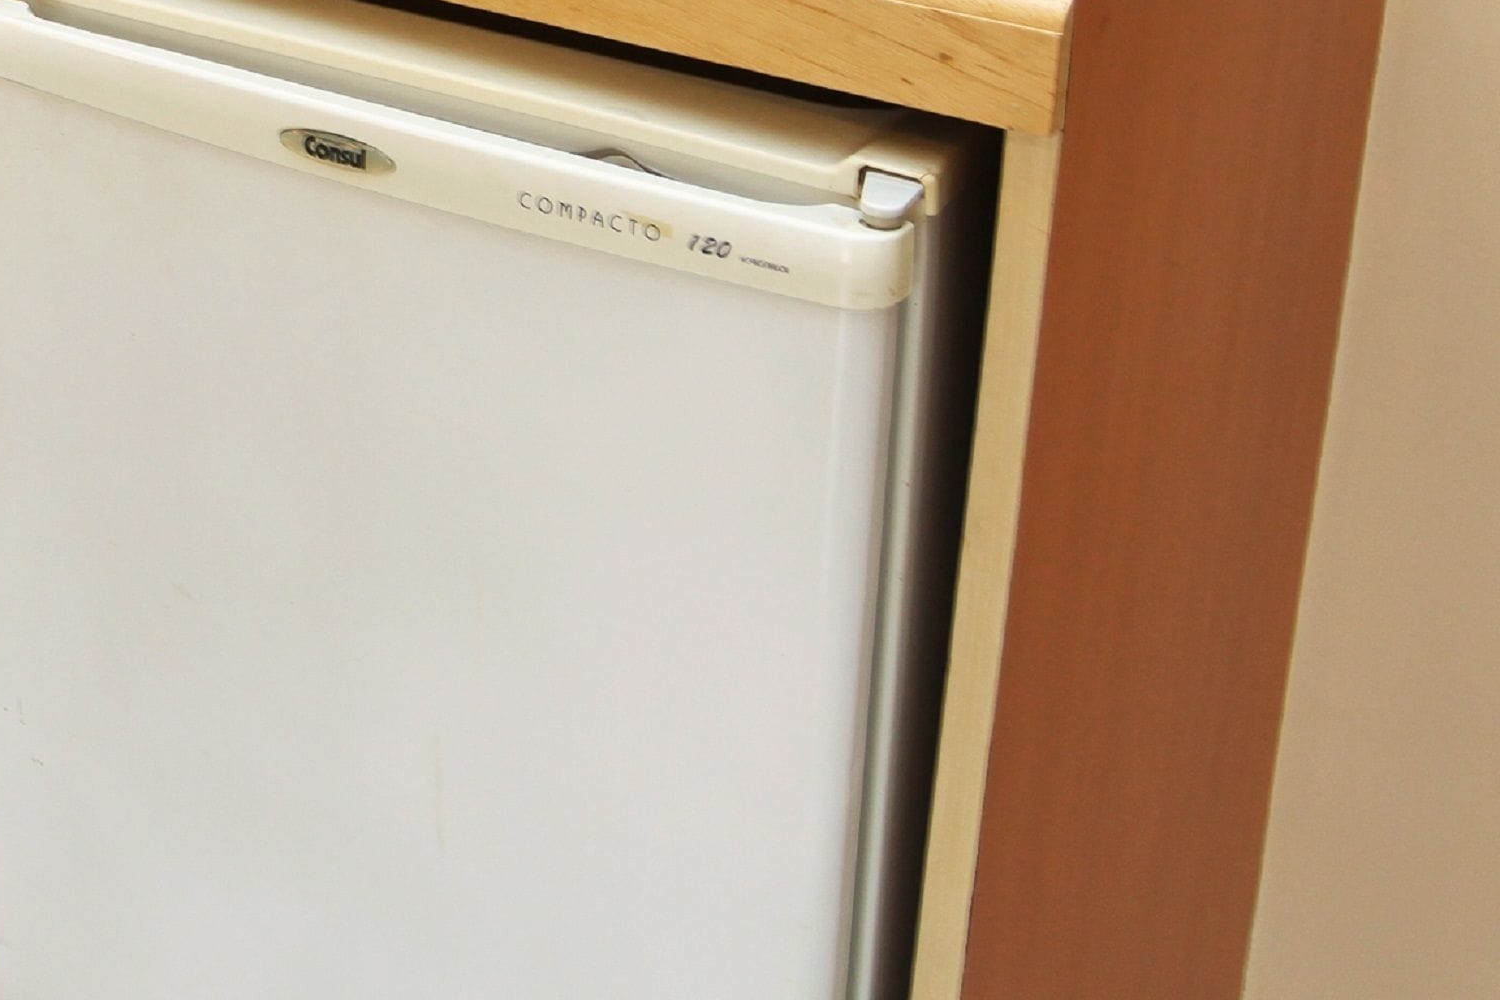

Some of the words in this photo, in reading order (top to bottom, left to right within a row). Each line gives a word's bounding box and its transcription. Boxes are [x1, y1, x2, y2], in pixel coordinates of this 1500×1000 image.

[305, 135, 367, 171] Consul
[518, 190, 662, 242] COMPACTO
[686, 232, 733, 259] 120
